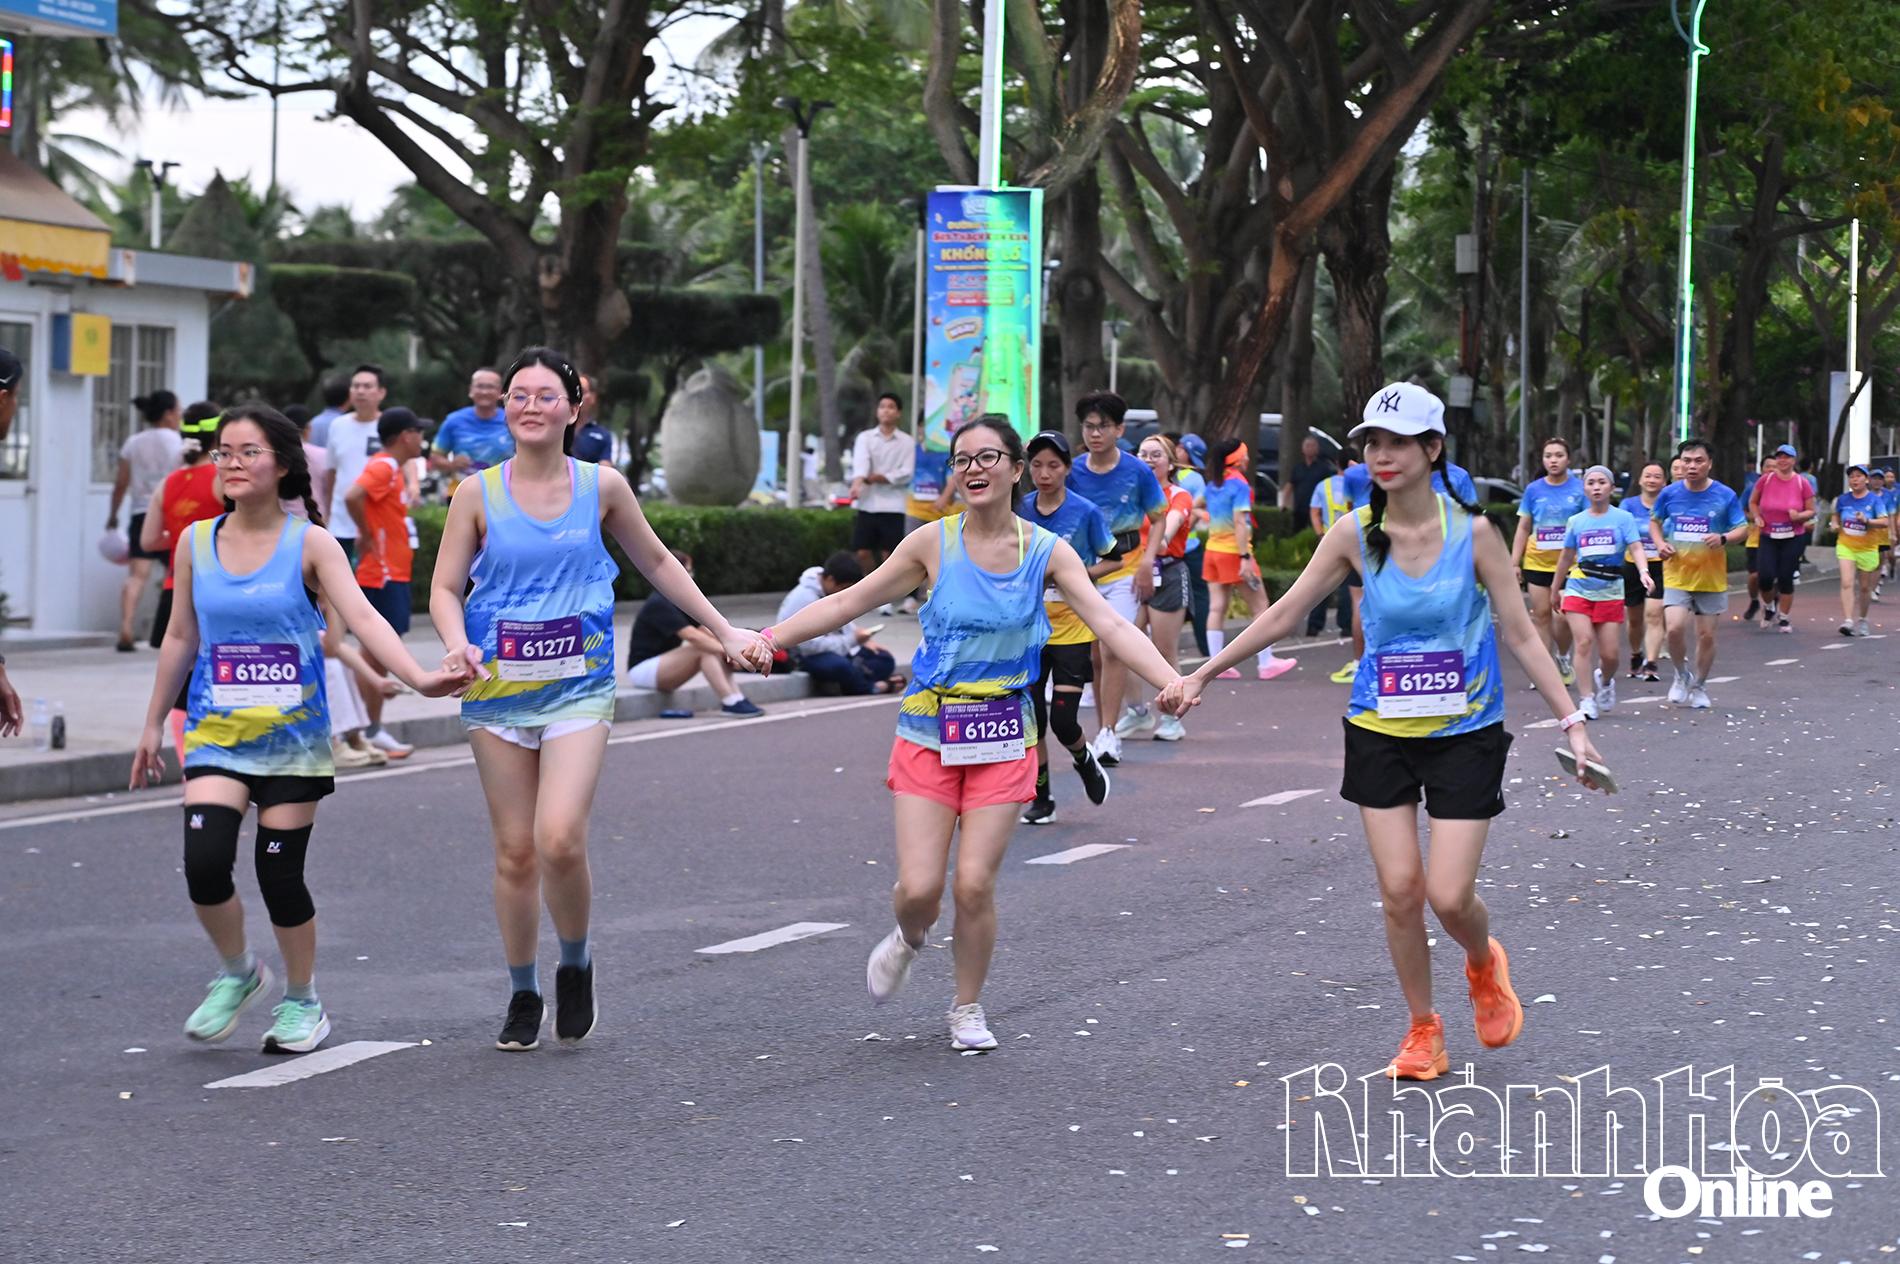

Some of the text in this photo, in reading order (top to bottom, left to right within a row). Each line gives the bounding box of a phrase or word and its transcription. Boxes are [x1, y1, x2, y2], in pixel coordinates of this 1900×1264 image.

[1377, 391, 1401, 413] NY
[505, 635, 577, 658] F 61277
[220, 663, 297, 681] F 61260
[1384, 671, 1460, 691] F 61259
[949, 719, 1020, 740] F 61263
